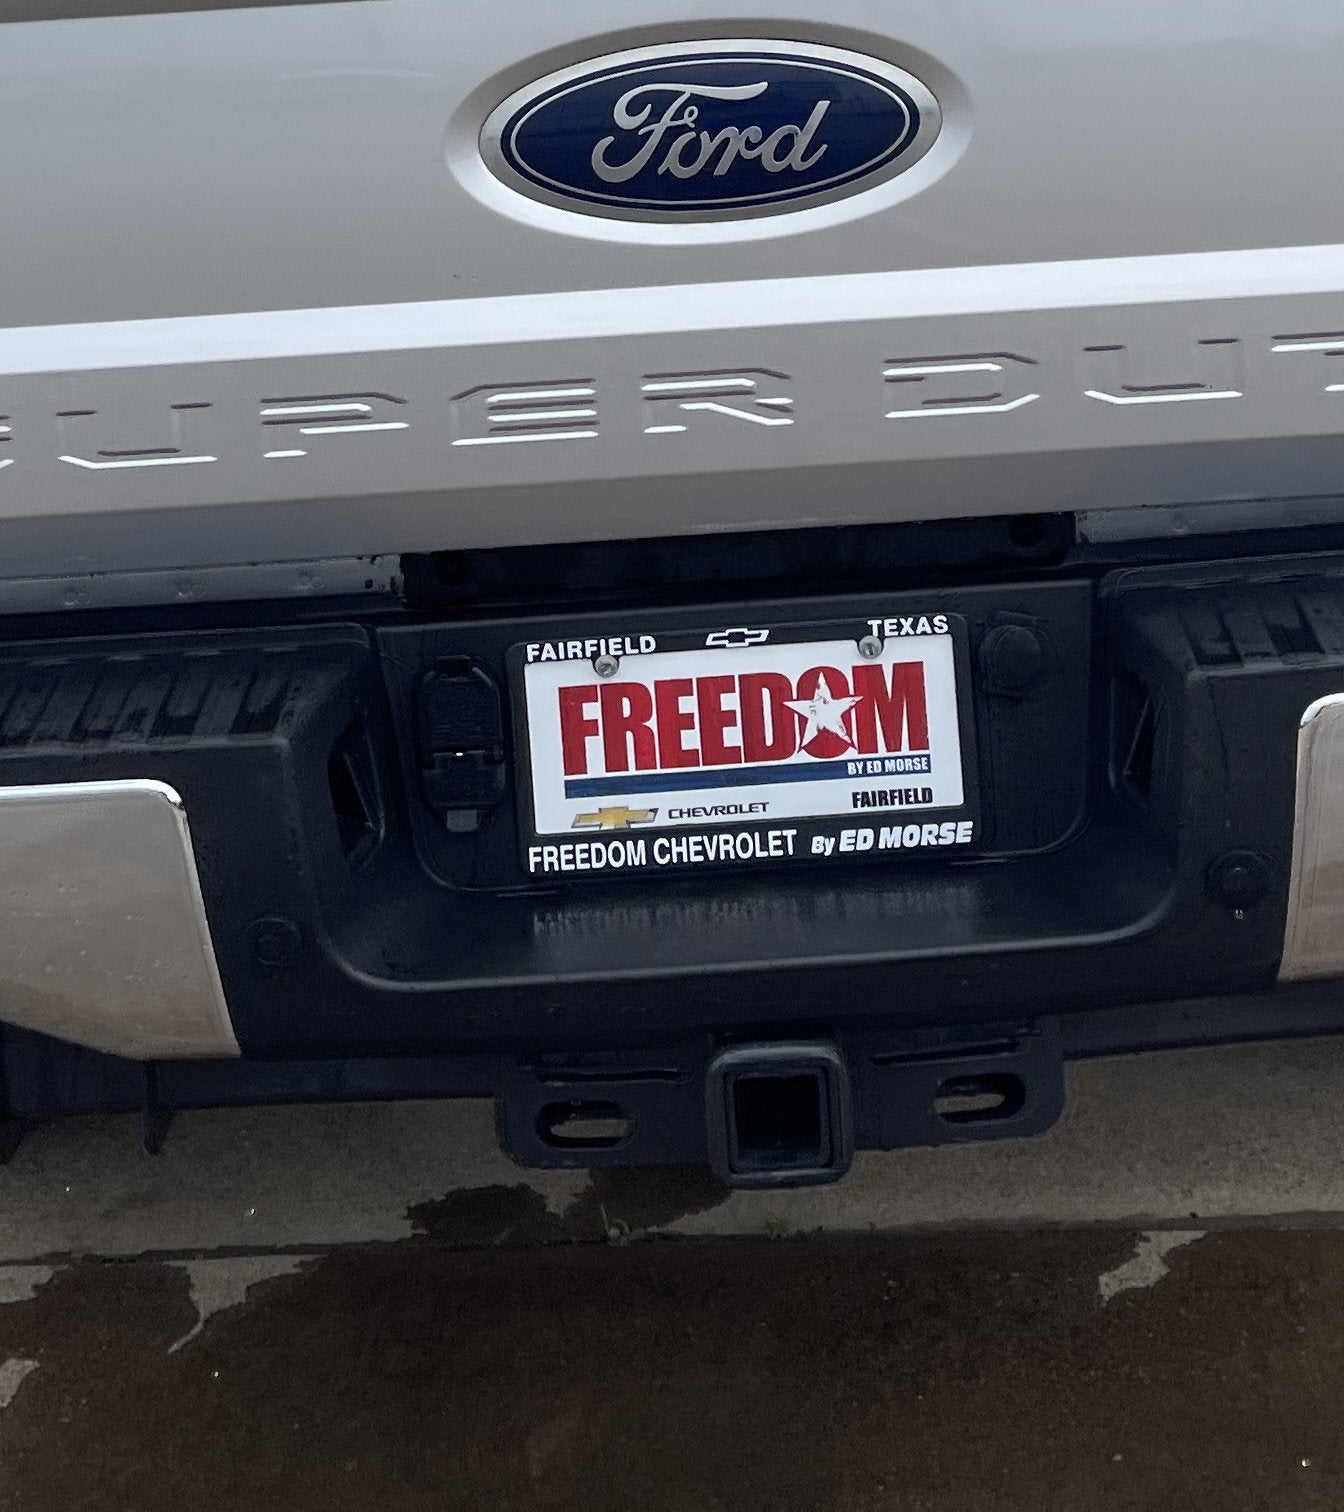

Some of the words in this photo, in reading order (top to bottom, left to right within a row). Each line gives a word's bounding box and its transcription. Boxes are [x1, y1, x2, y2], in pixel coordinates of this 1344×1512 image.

[591, 81, 831, 184] Ford
[867, 614, 949, 637] TEXAS
[526, 635, 656, 663] FAIRFIELD
[558, 661, 930, 776] FREEDOM
[847, 761, 864, 776] BY
[866, 759, 882, 775] ED
[884, 757, 929, 773] MORSE
[667, 801, 770, 820] CHEVROLET
[852, 787, 934, 809] FAIRFIELD
[528, 839, 647, 873] FREEDOM
[652, 829, 798, 865] CHEVROLET
[811, 835, 836, 857] By
[839, 828, 875, 852] ED
[878, 821, 974, 850] MORSE
